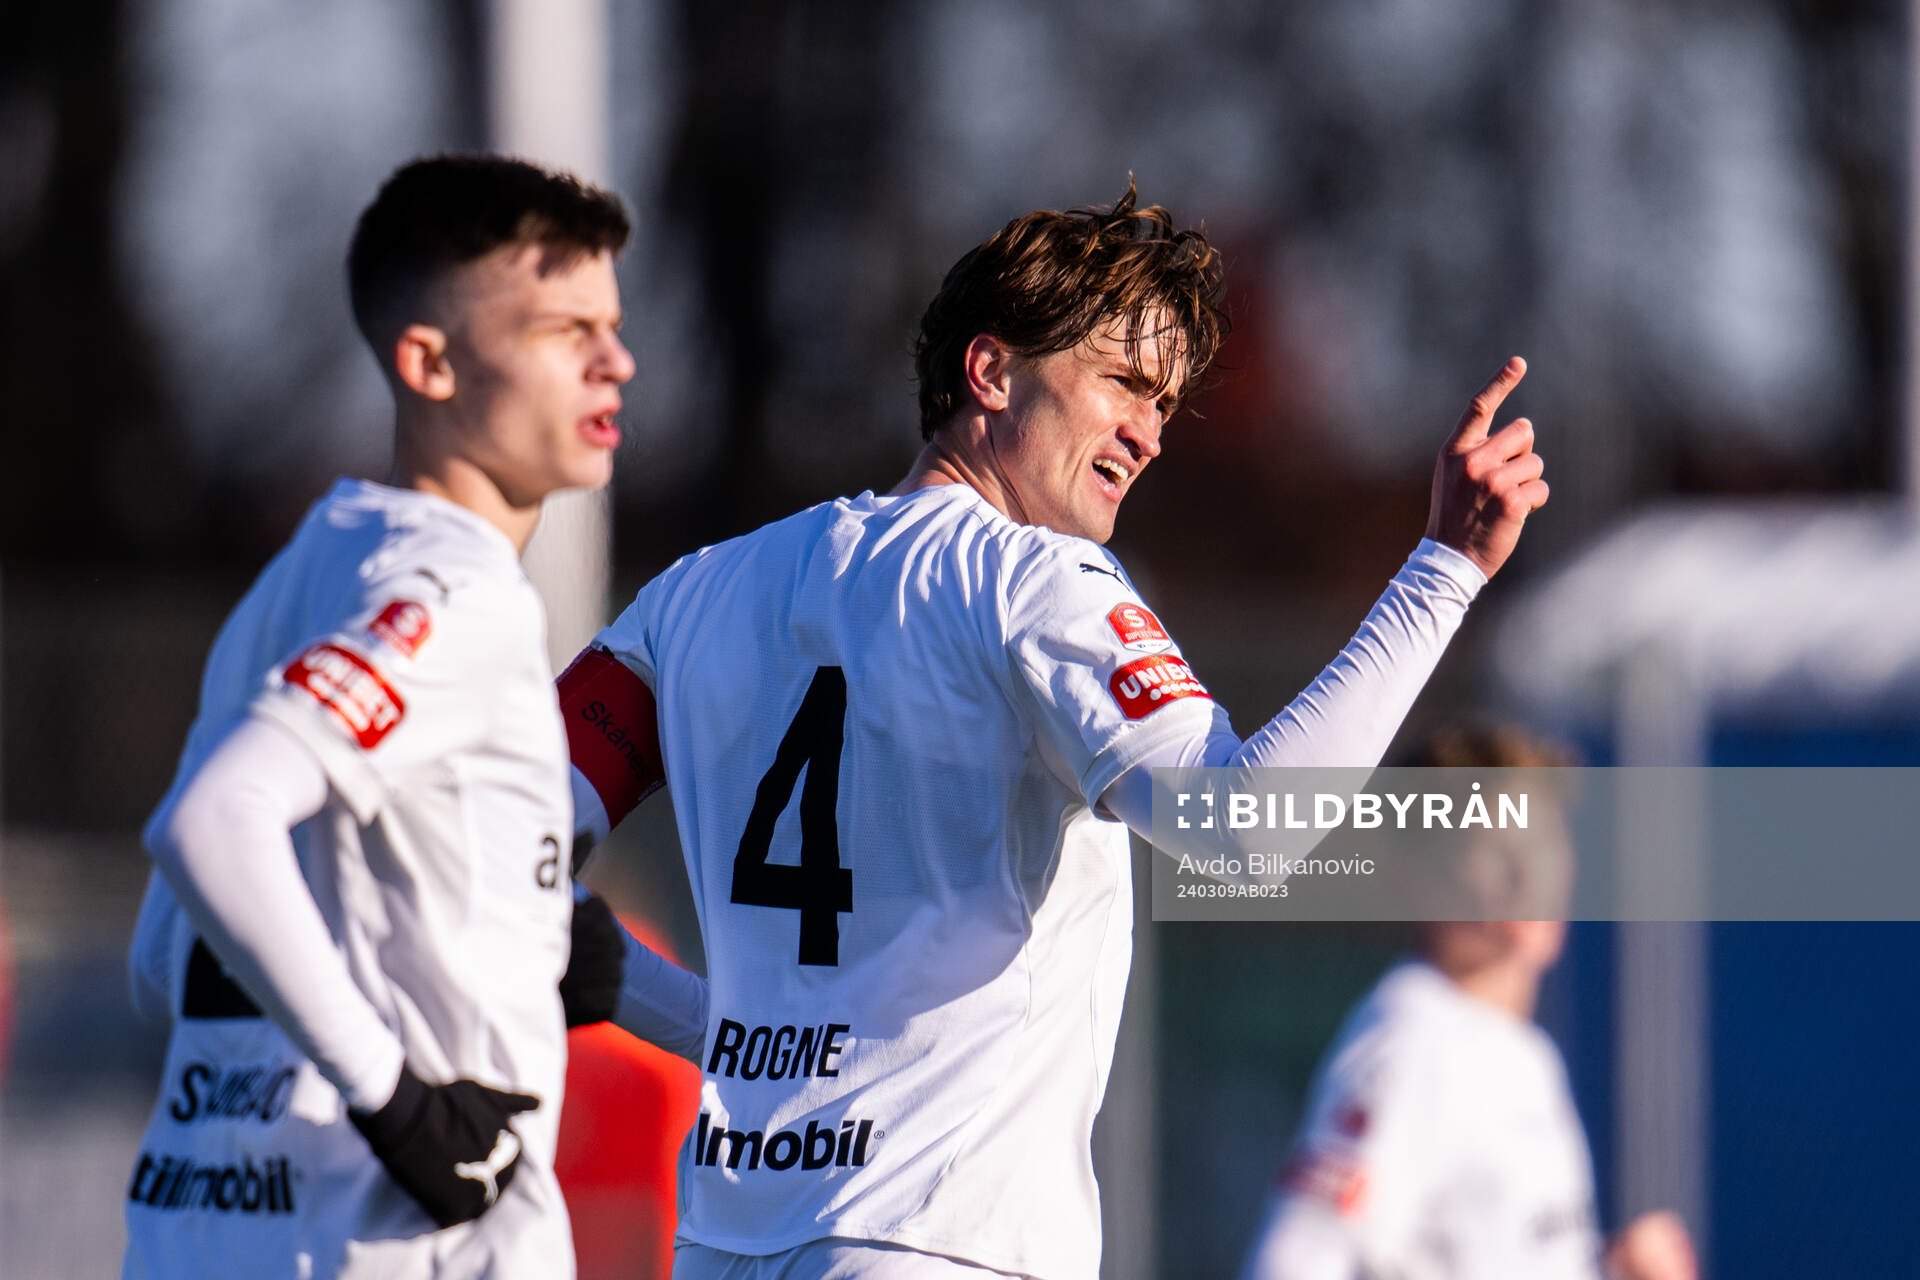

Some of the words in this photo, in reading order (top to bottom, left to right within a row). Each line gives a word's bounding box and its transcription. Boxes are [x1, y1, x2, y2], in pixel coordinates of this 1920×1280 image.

[1123, 608, 1146, 629] S
[730, 666, 853, 967] 4
[707, 1017, 850, 1081] ROGNE
